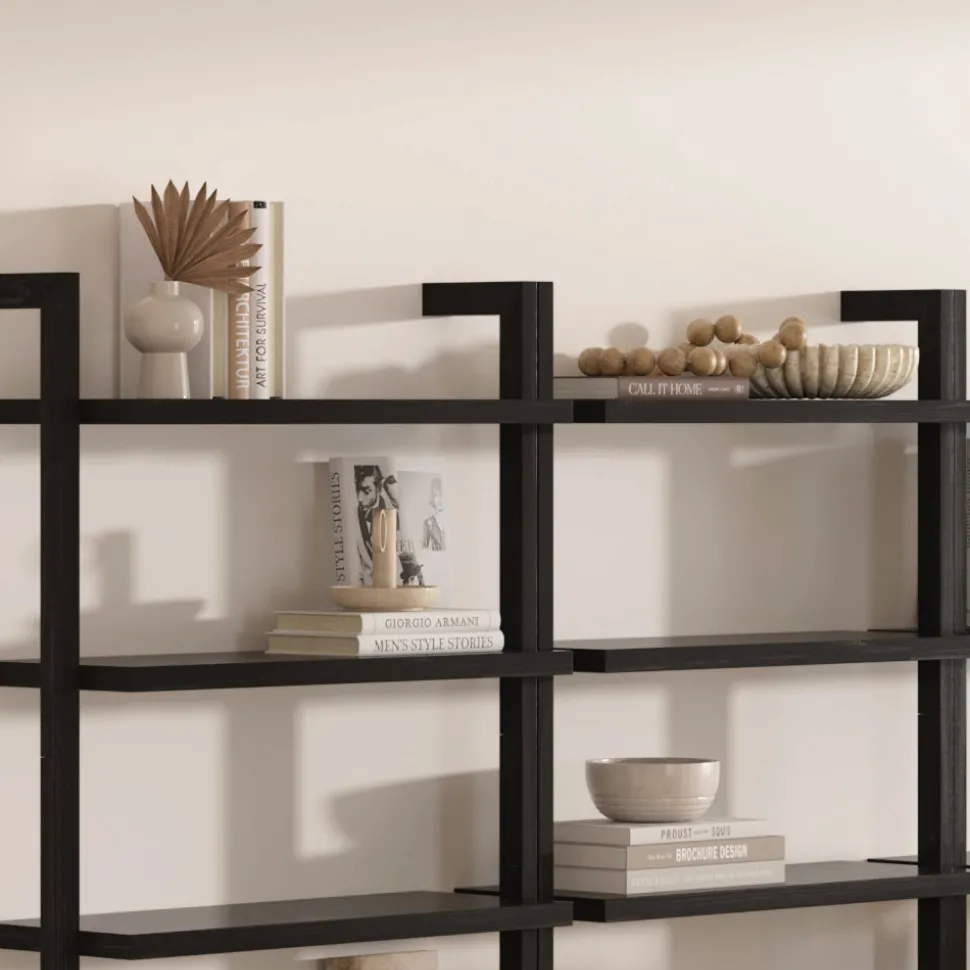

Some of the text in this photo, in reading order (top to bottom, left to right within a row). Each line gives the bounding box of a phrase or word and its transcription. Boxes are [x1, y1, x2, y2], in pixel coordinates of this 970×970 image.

[256, 283, 267, 388] ART FOR SURVIVAL
[628, 382, 656, 396] CALL
[657, 382, 669, 396] IT
[670, 382, 703, 396] HOME
[331, 472, 345, 582] STYLE STORIES
[385, 616, 479, 629] GIORGIO ARMANI
[374, 636, 494, 652] MEN'S STYLE STORIES
[660, 828, 692, 839] PROUST
[676, 846, 718, 862] BROCHURE
[720, 844, 748, 859] DESIGN
